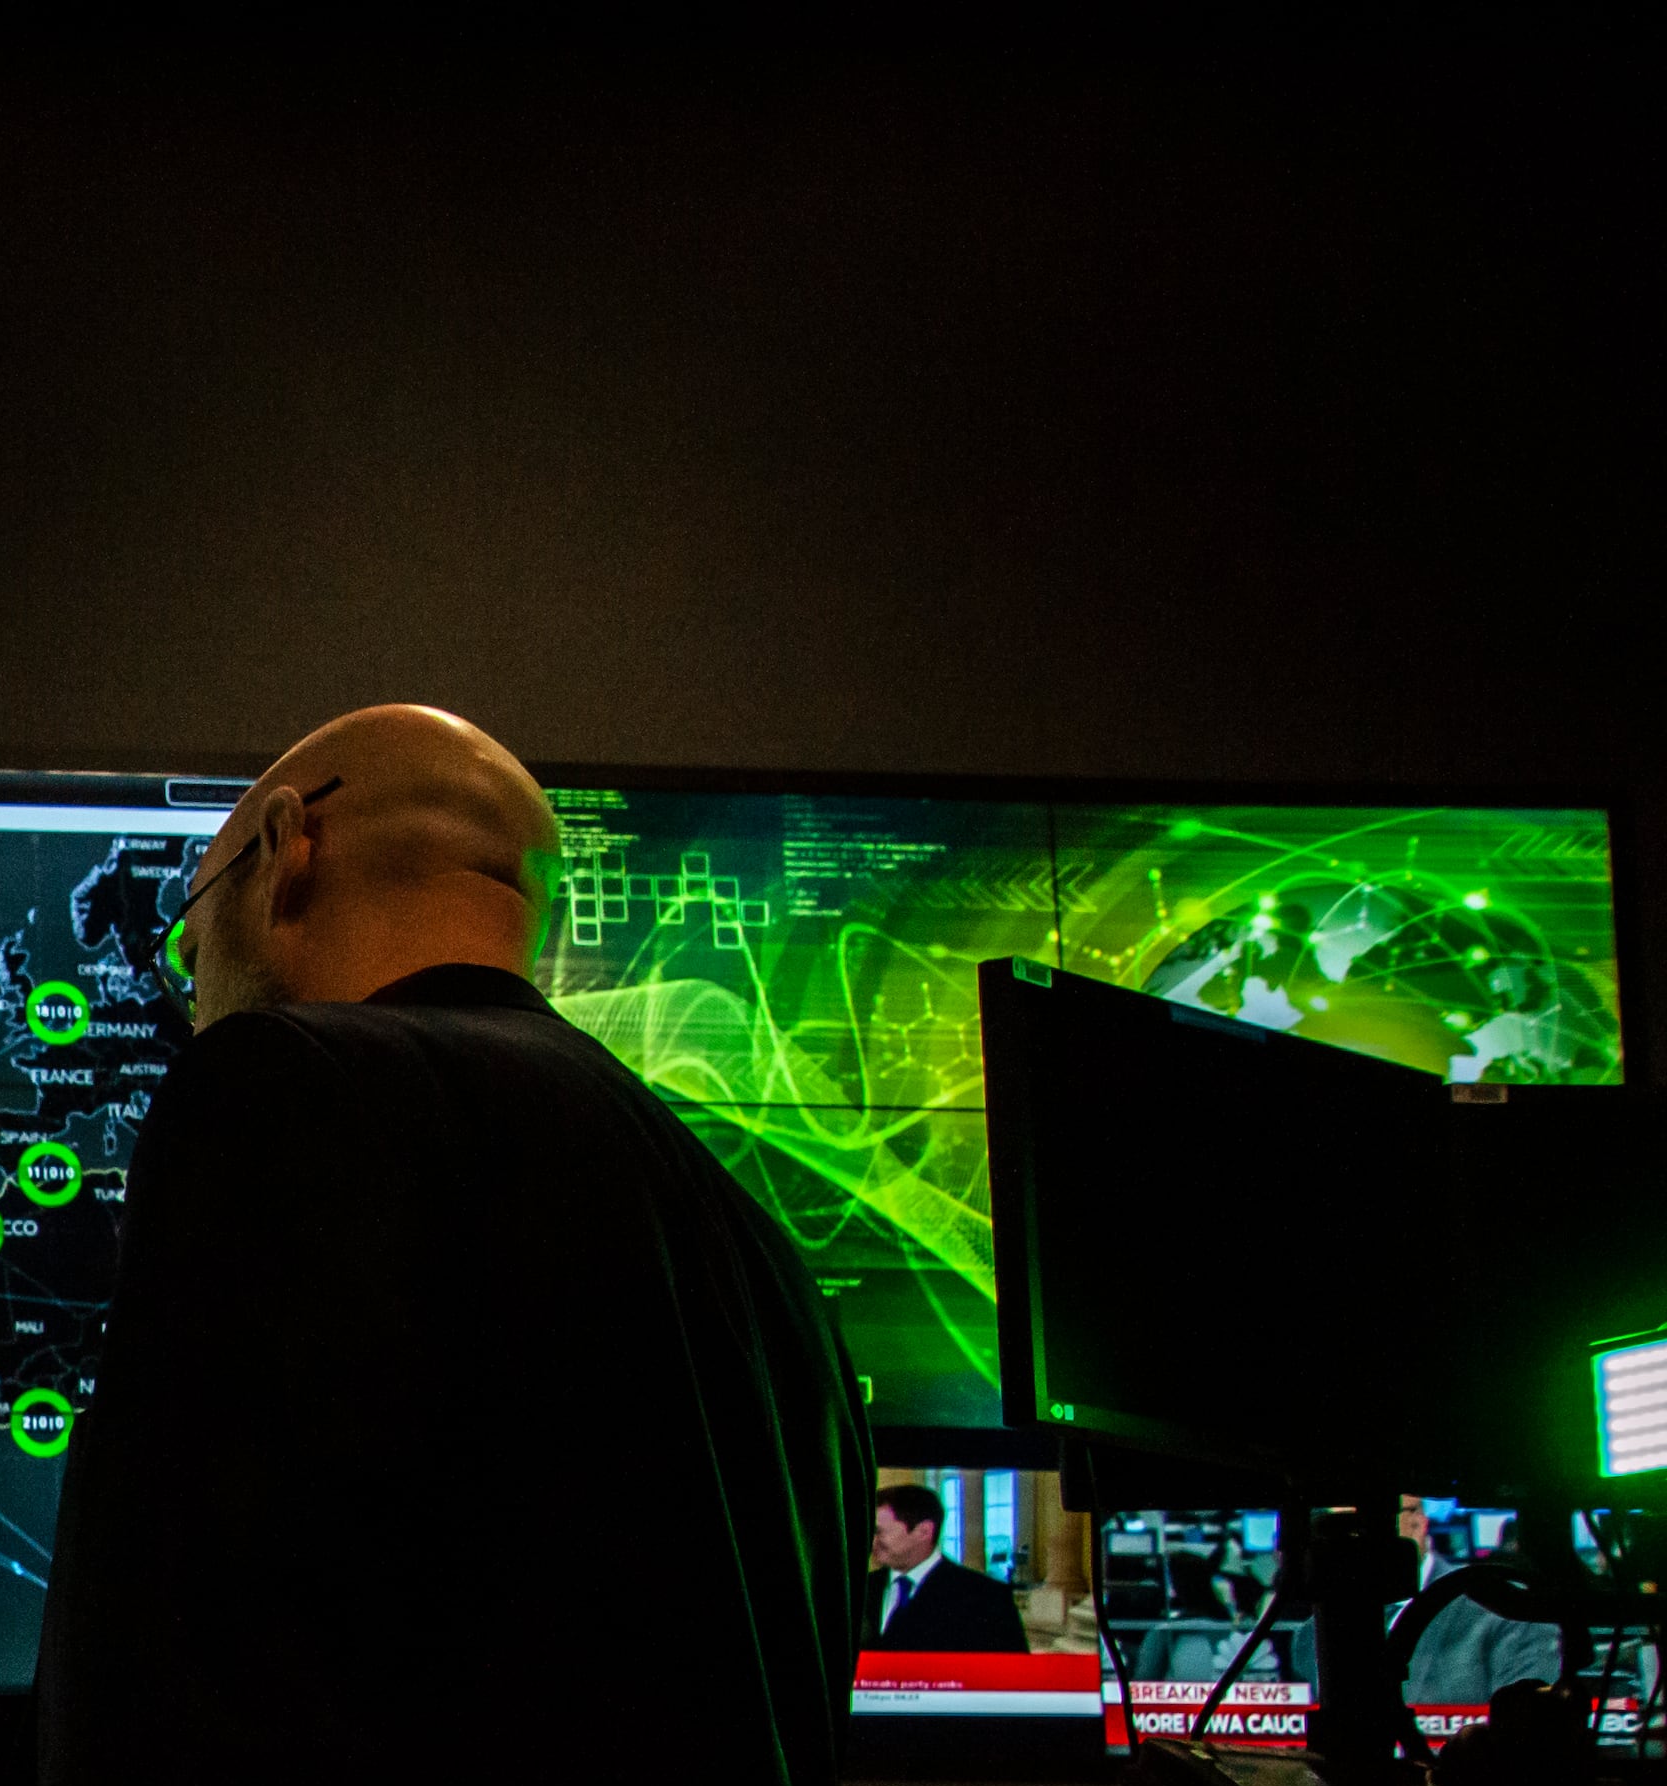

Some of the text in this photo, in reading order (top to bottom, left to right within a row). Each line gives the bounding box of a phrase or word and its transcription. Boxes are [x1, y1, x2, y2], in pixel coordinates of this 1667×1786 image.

[1129, 1683, 1292, 1702] BREAKIN NEWS
[1132, 1713, 1185, 1734] MORE
[1189, 1713, 1242, 1734] IWA
